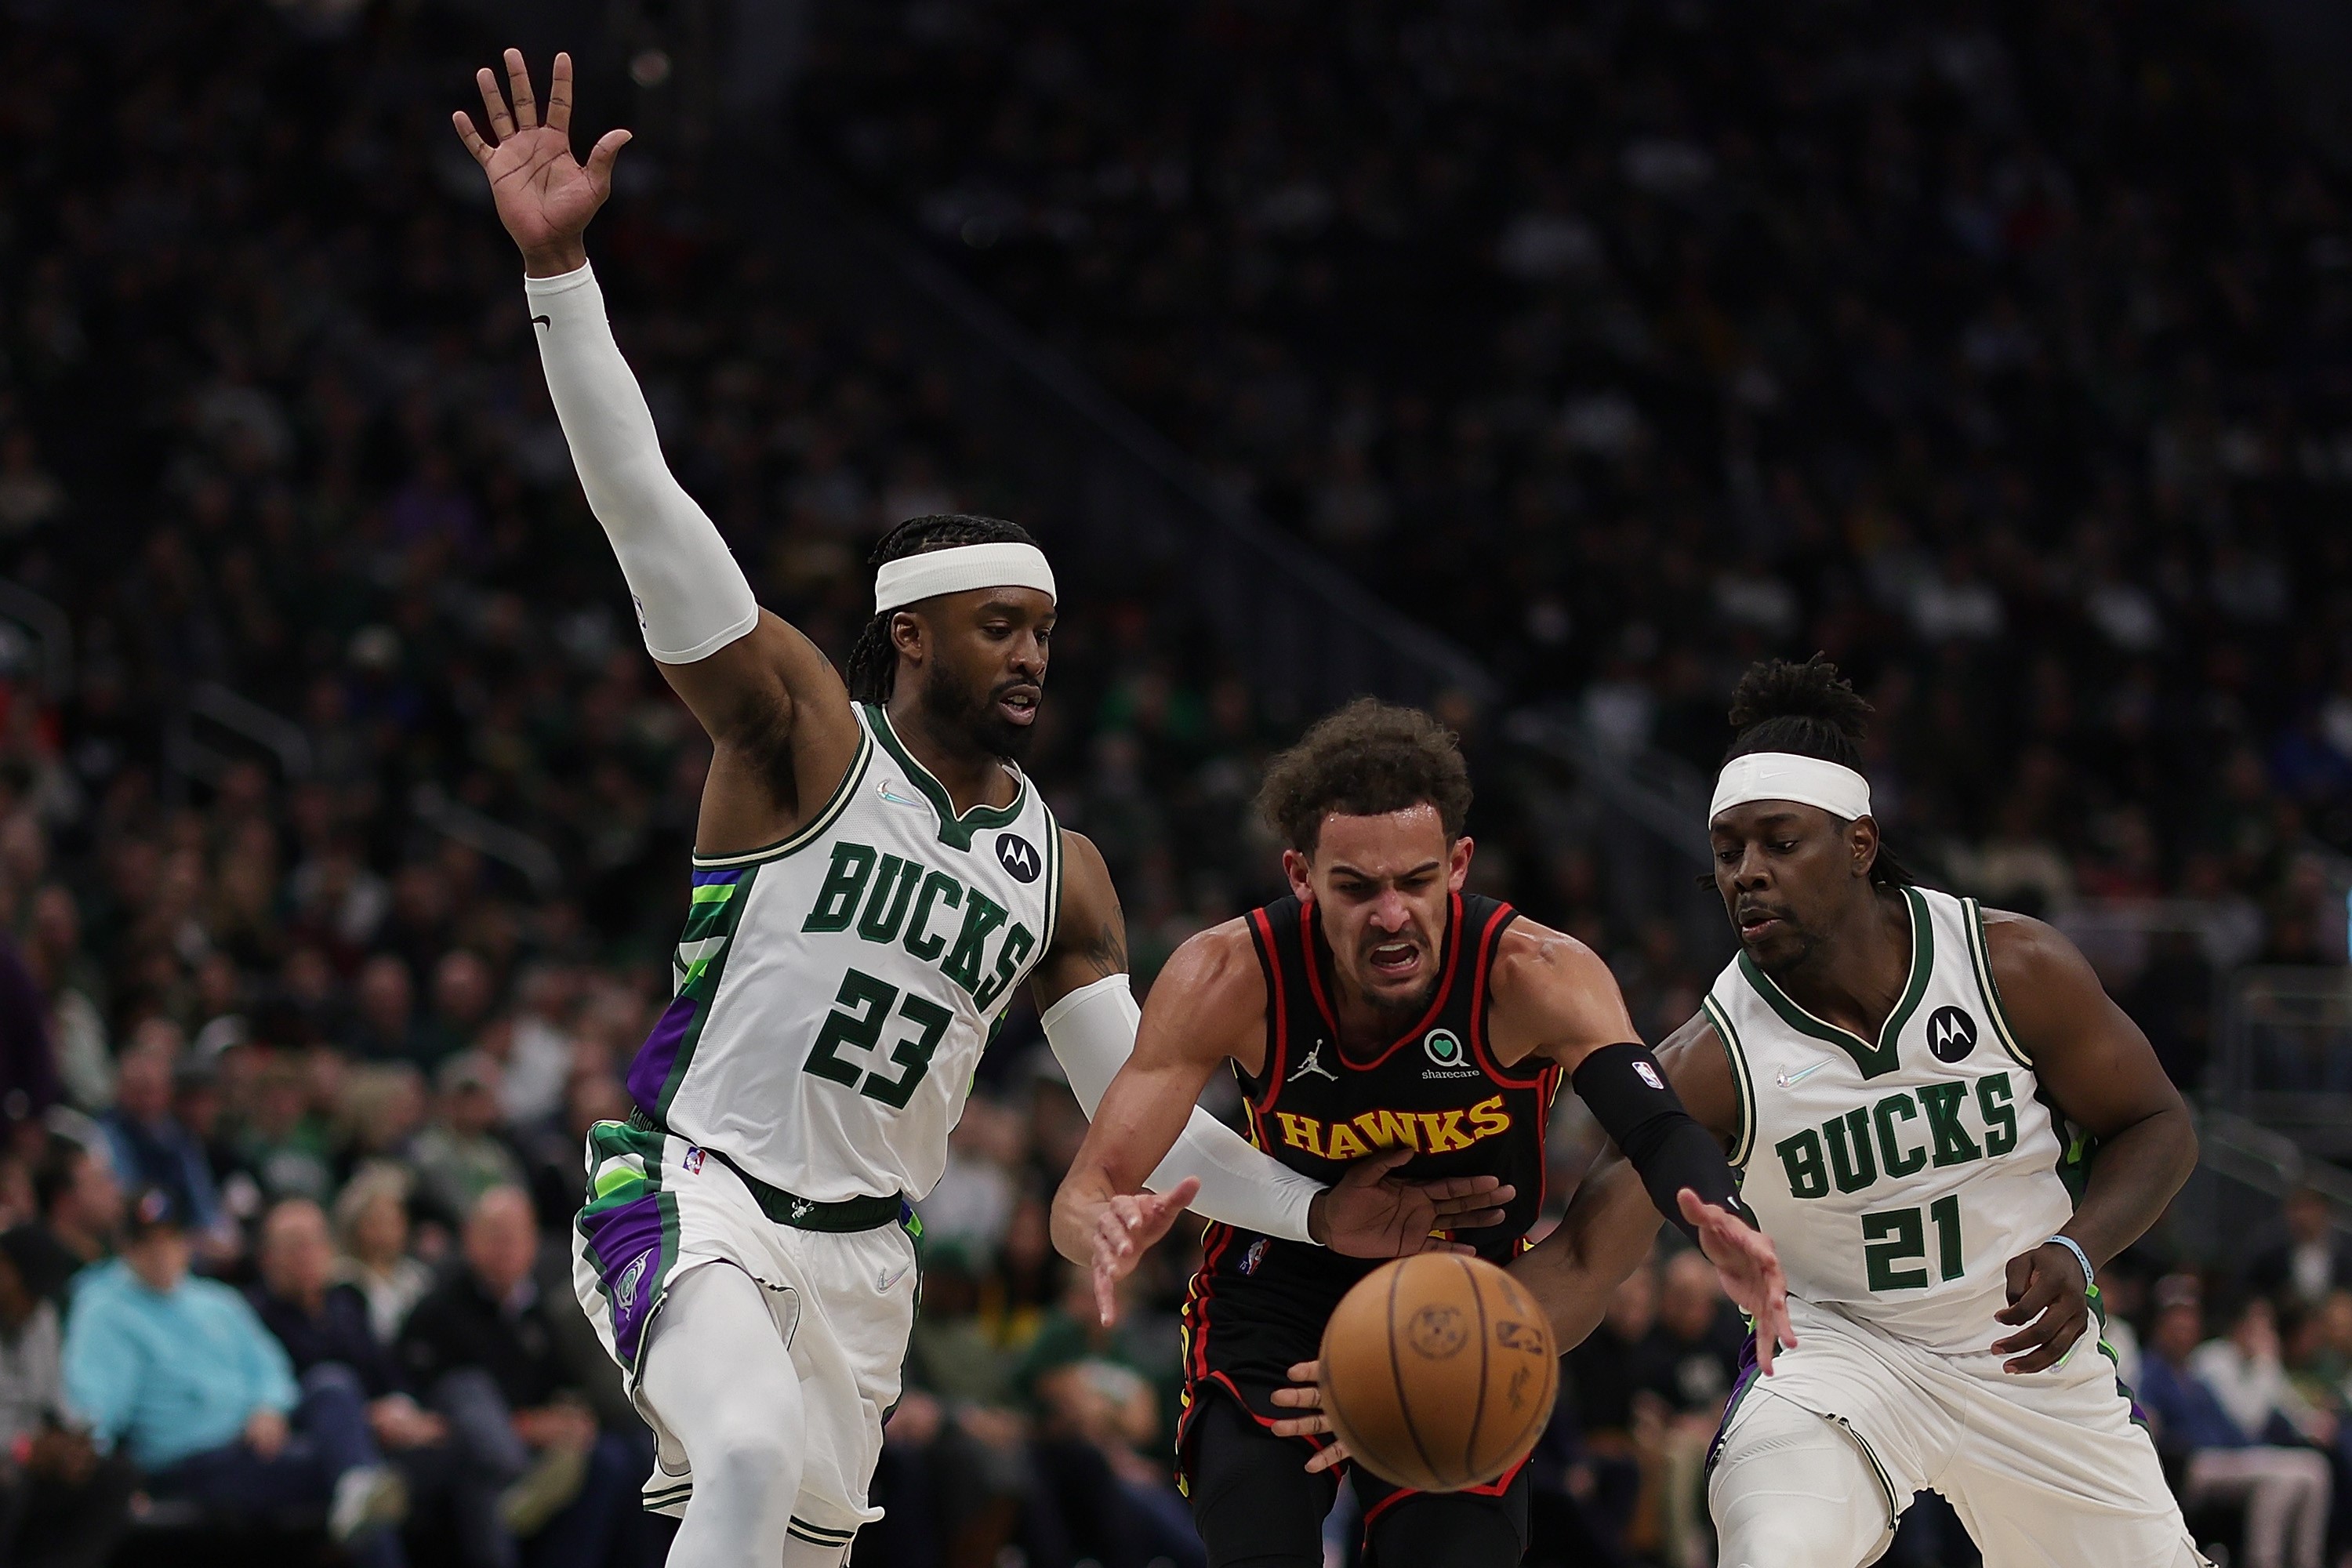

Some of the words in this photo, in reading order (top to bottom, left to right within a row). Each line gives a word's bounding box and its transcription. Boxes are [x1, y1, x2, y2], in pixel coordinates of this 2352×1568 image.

[801, 841, 1035, 1014] BUCKS
[804, 967, 953, 1110] 23
[1421, 1069, 1480, 1080] sharecare
[1274, 1094, 1512, 1160] HAWKS
[1774, 1071, 2018, 1199] BUCKS
[1860, 1193, 1965, 1292] 21
